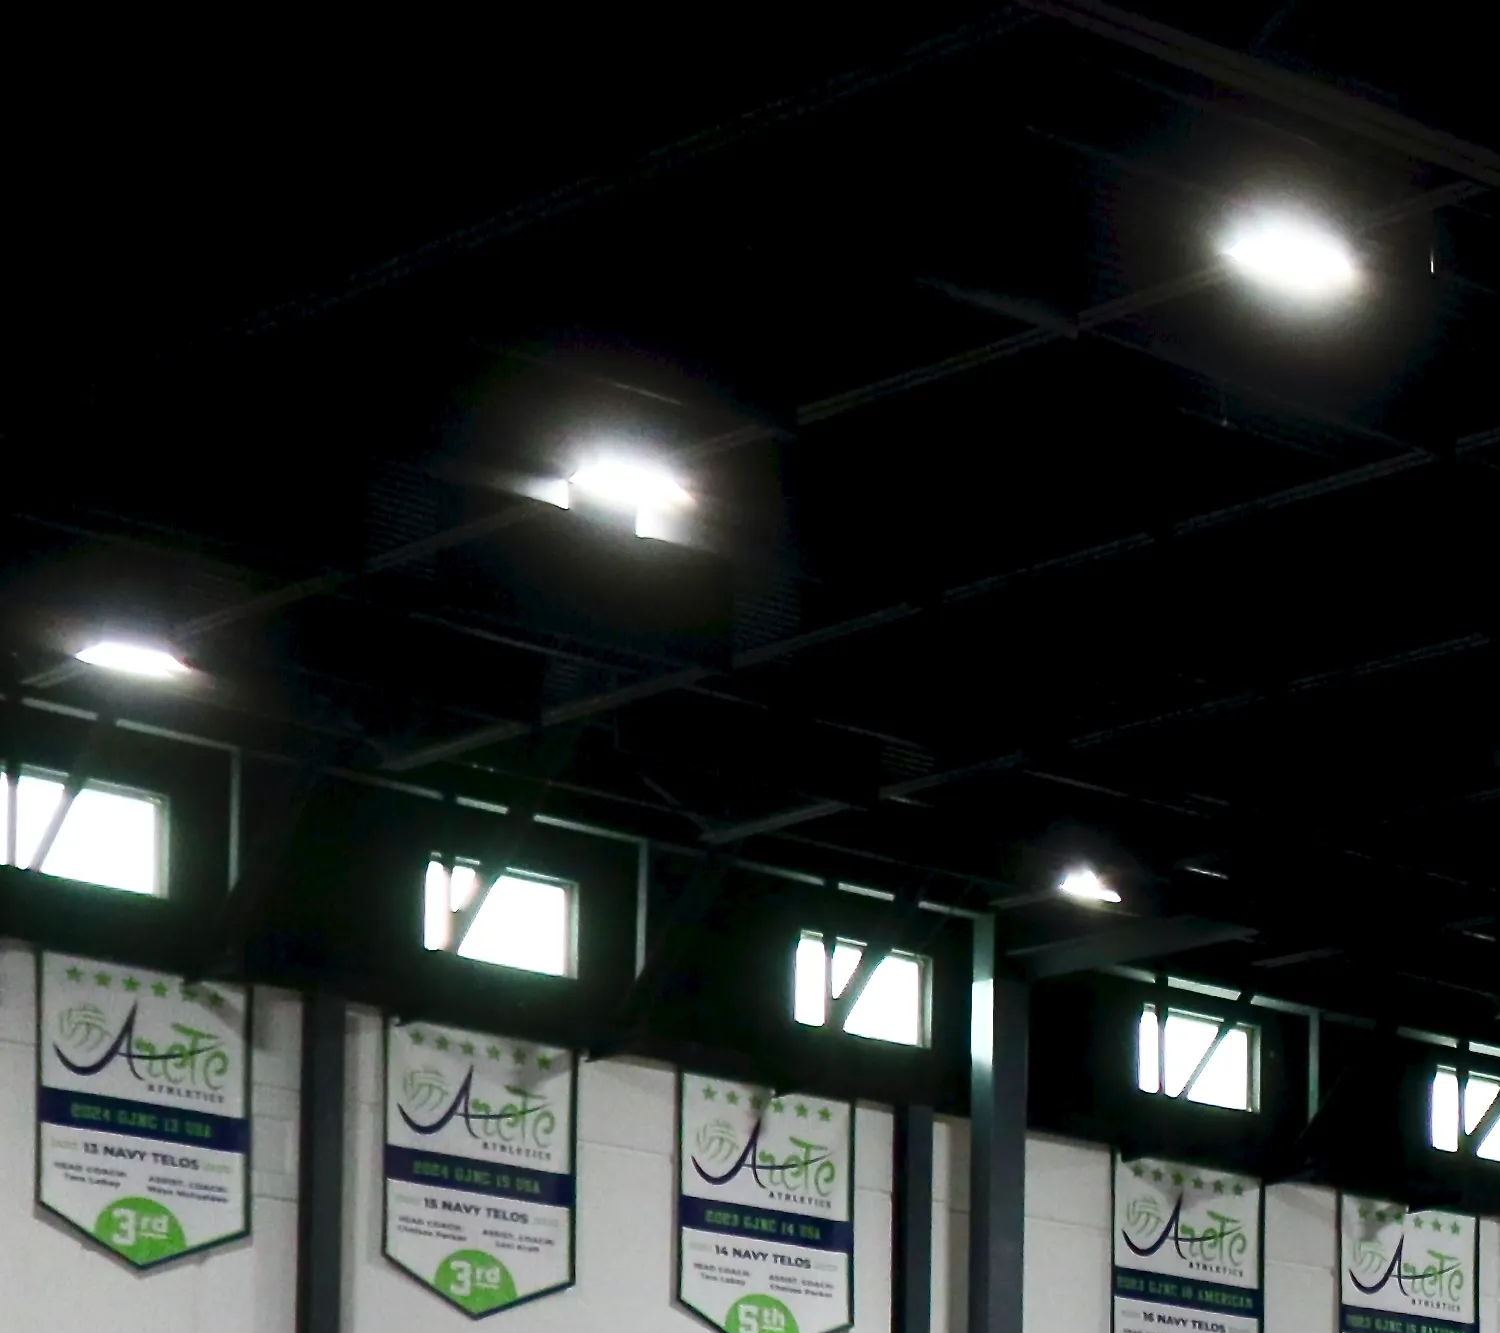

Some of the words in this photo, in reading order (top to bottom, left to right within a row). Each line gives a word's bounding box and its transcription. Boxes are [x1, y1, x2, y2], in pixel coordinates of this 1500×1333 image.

[83, 1142, 98, 1154] 13
[103, 1144, 146, 1162] NAVY
[151, 1152, 199, 1170] TELOS
[424, 1197, 438, 1209] 15
[441, 1200, 480, 1216] NAVY
[486, 1207, 529, 1224] TELOS
[768, 1191, 832, 1209] ATHLETICS
[109, 1207, 169, 1246] 3rd
[714, 1244, 729, 1256] 14
[733, 1247, 769, 1263] NAVY
[773, 1254, 812, 1270] TELOS
[450, 1260, 500, 1297] 3rd
[1142, 1311, 1155, 1323] 16
[1157, 1314, 1188, 1329] NAVY
